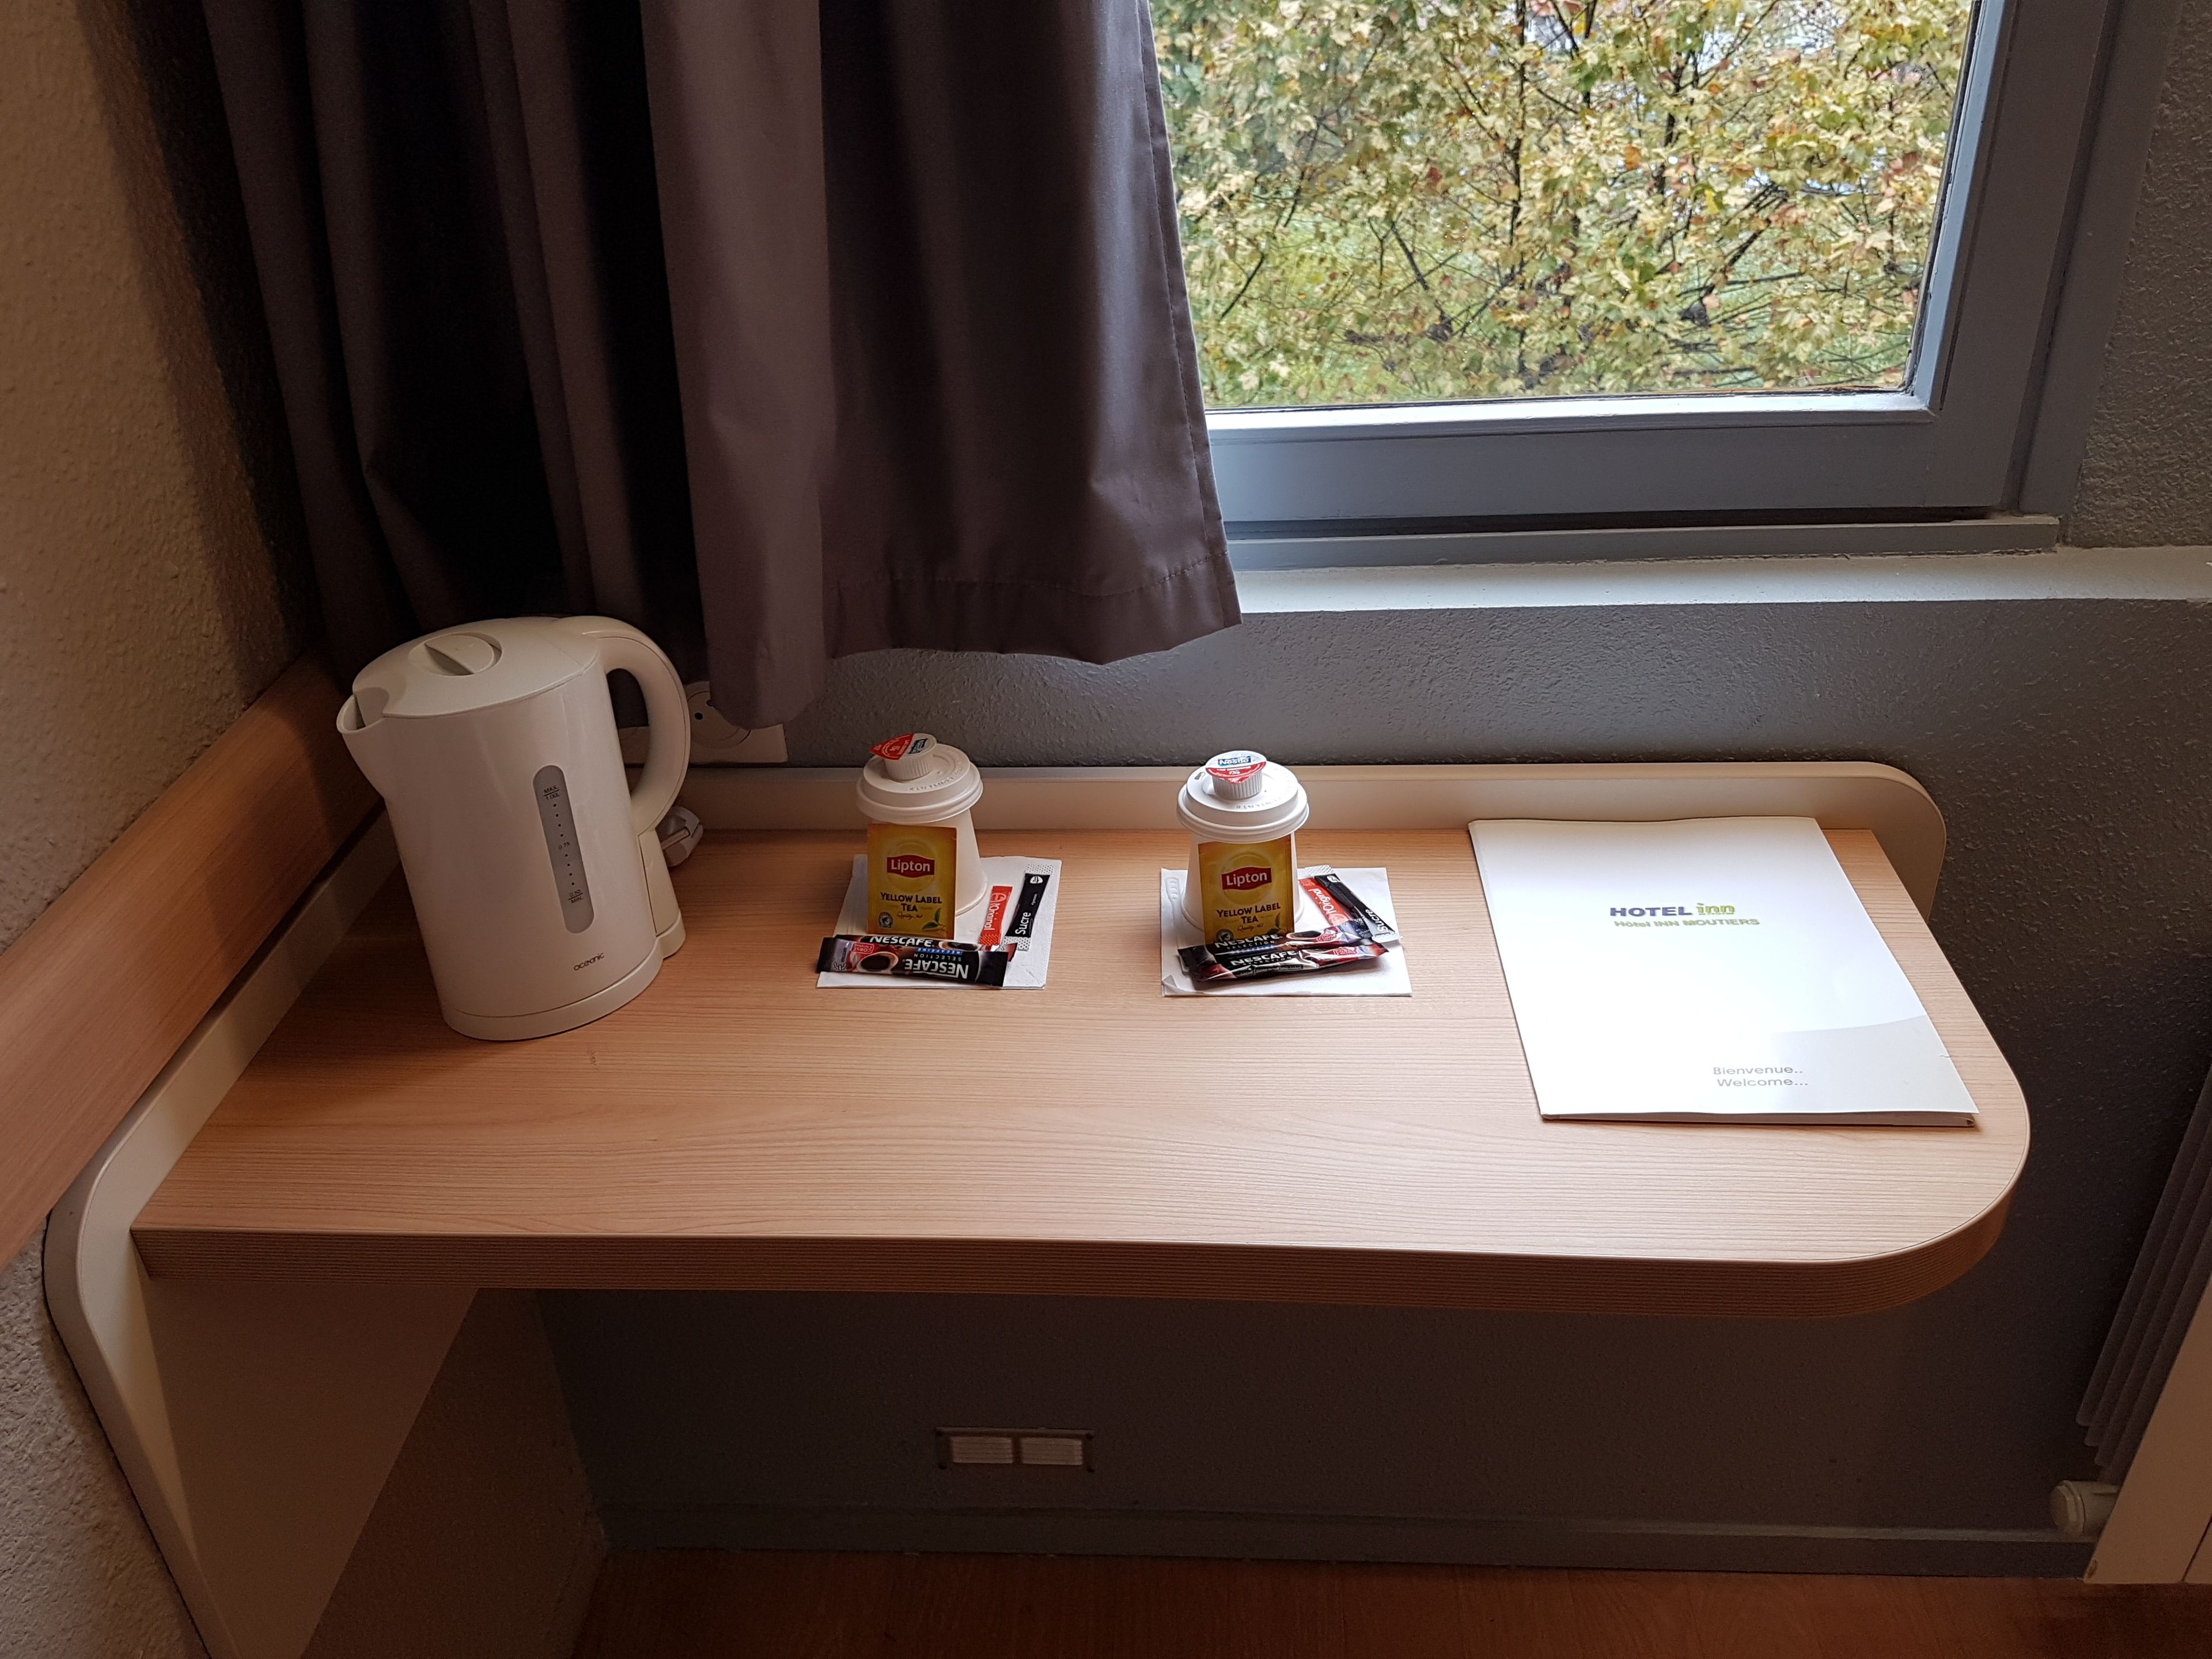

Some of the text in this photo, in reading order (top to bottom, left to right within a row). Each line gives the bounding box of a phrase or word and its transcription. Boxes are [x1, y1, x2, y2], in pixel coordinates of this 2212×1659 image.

[891, 859, 930, 873] Lipton
[1226, 872, 1267, 887] Lipton
[880, 892, 942, 904] YELLOW LABEL
[901, 903, 918, 911] TEA
[1217, 902, 1281, 917] YELLOW LABEL
[1610, 903, 1735, 916] HOTEL inn
[1015, 912, 1031, 934] Sucre
[1241, 916, 1259, 924] TEA
[1365, 909, 1388, 932] Sucre
[1227, 940, 1275, 949] SELECTION
[574, 953, 604, 971] oceanic
[914, 953, 961, 961] SELECTION
